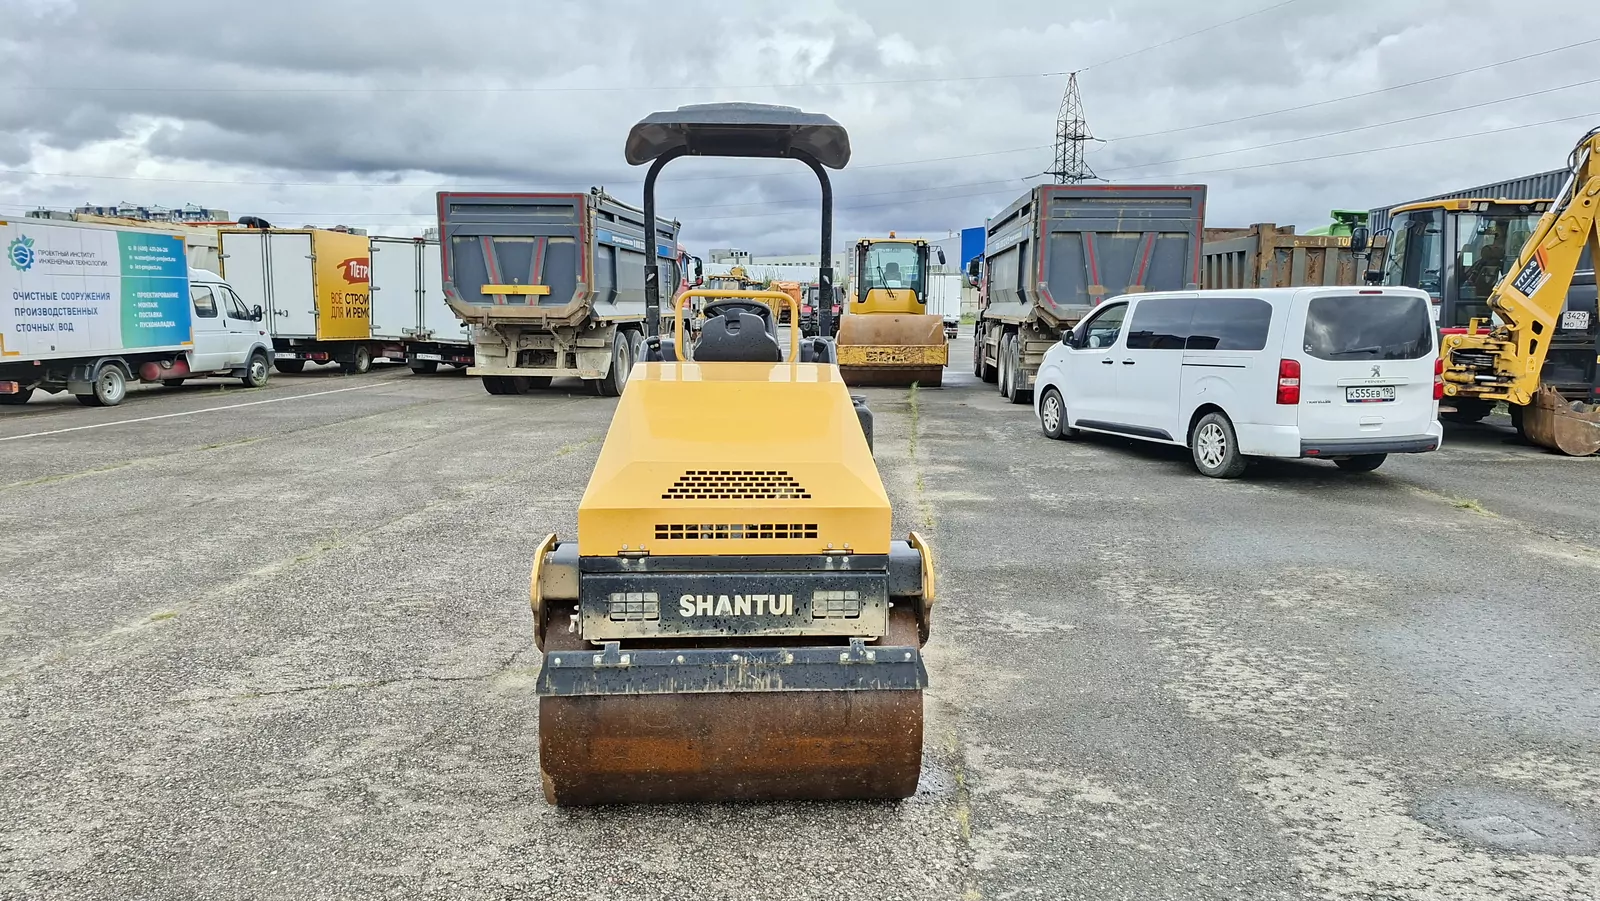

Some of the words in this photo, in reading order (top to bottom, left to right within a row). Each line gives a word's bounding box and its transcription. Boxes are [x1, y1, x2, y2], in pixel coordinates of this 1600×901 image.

[38, 249, 69, 257] ПРОЕКТНЫЙ
[75, 259, 108, 267] ТЕХНОЛОГИИ
[13, 292, 58, 300] ОЧИСТНЫЕ
[61, 292, 111, 300] СООРУЖЕНИЯ
[331, 290, 343, 304] ВСЁ
[14, 307, 98, 317] ПРОИЗВОДСТВЕННЫХ
[331, 307, 344, 319] ДЛЯ
[346, 307, 351, 318] И
[1567, 312, 1586, 320] 3429
[15, 323, 55, 332] СТОЧНЫХ
[58, 322, 74, 332] ВОД
[679, 594, 793, 617] SHANTUI
